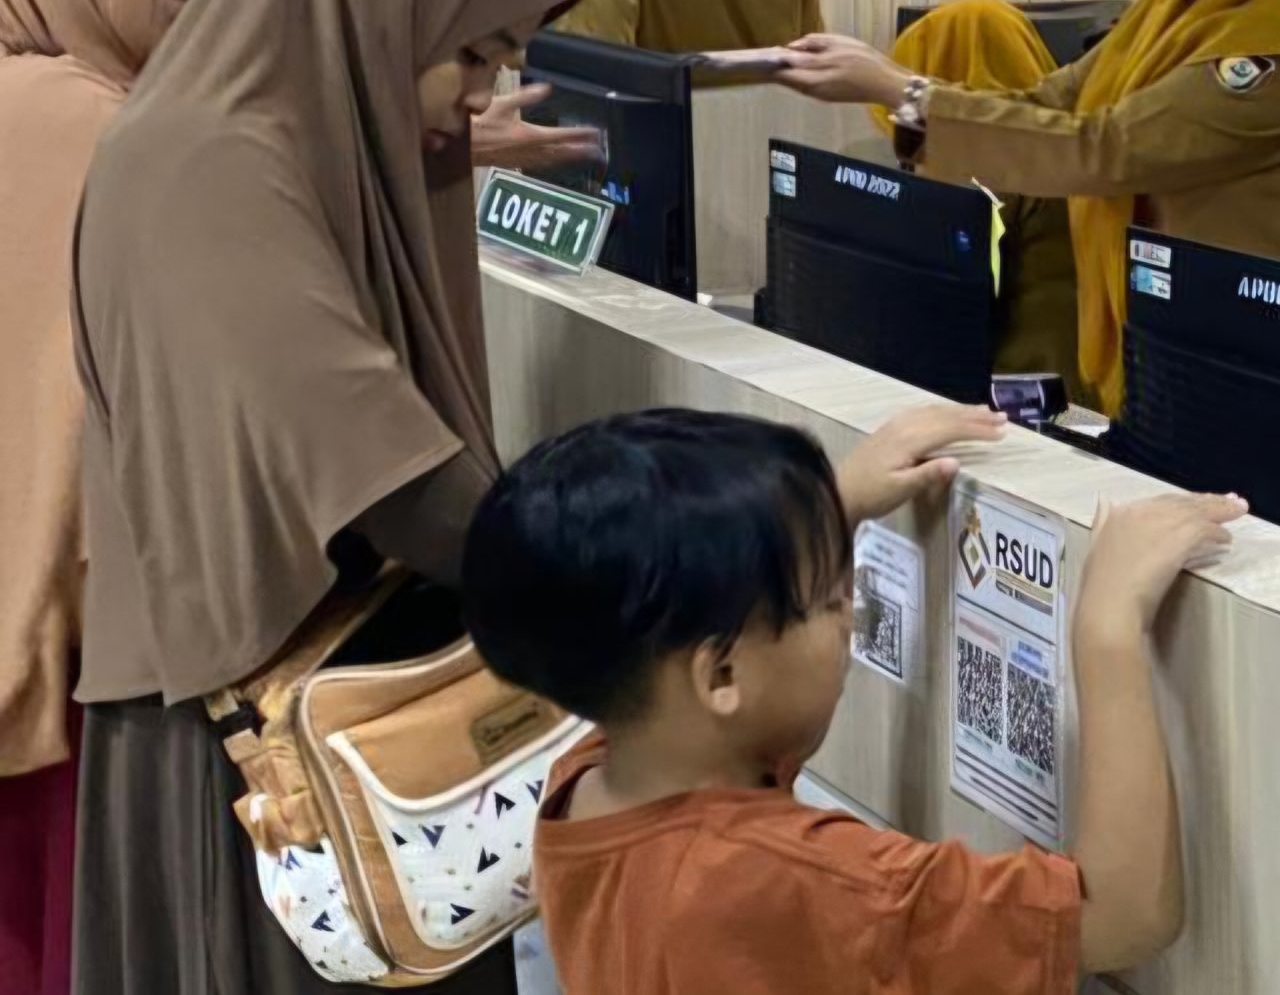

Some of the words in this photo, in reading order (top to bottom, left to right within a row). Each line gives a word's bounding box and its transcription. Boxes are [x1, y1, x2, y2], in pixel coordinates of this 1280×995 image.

[487, 188, 571, 246] LOKET
[572, 219, 588, 255] 1
[996, 532, 1053, 589] RSUD
